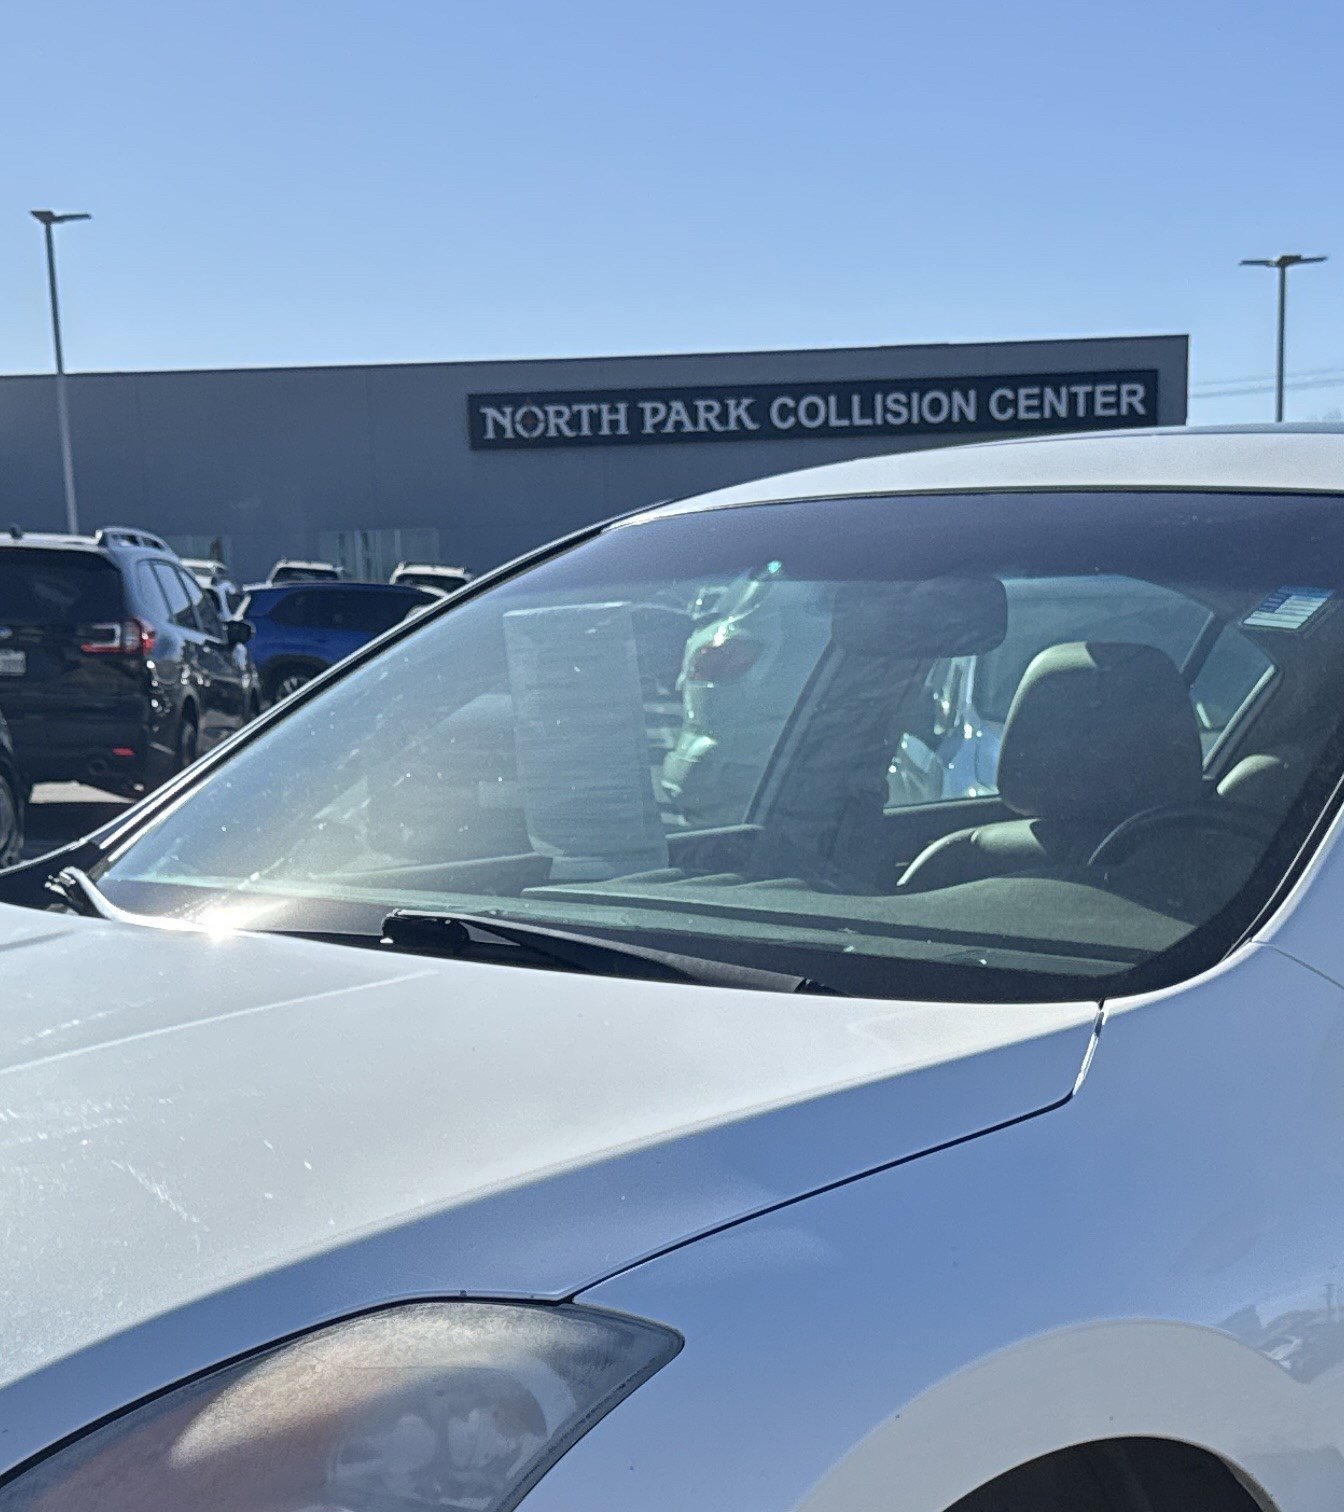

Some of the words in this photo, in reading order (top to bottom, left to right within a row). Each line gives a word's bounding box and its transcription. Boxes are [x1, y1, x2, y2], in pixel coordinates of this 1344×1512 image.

[479, 402, 629, 440] NORTH
[637, 399, 761, 434] PARK
[769, 389, 977, 430] COLLISION
[988, 383, 1147, 421] CENTER
